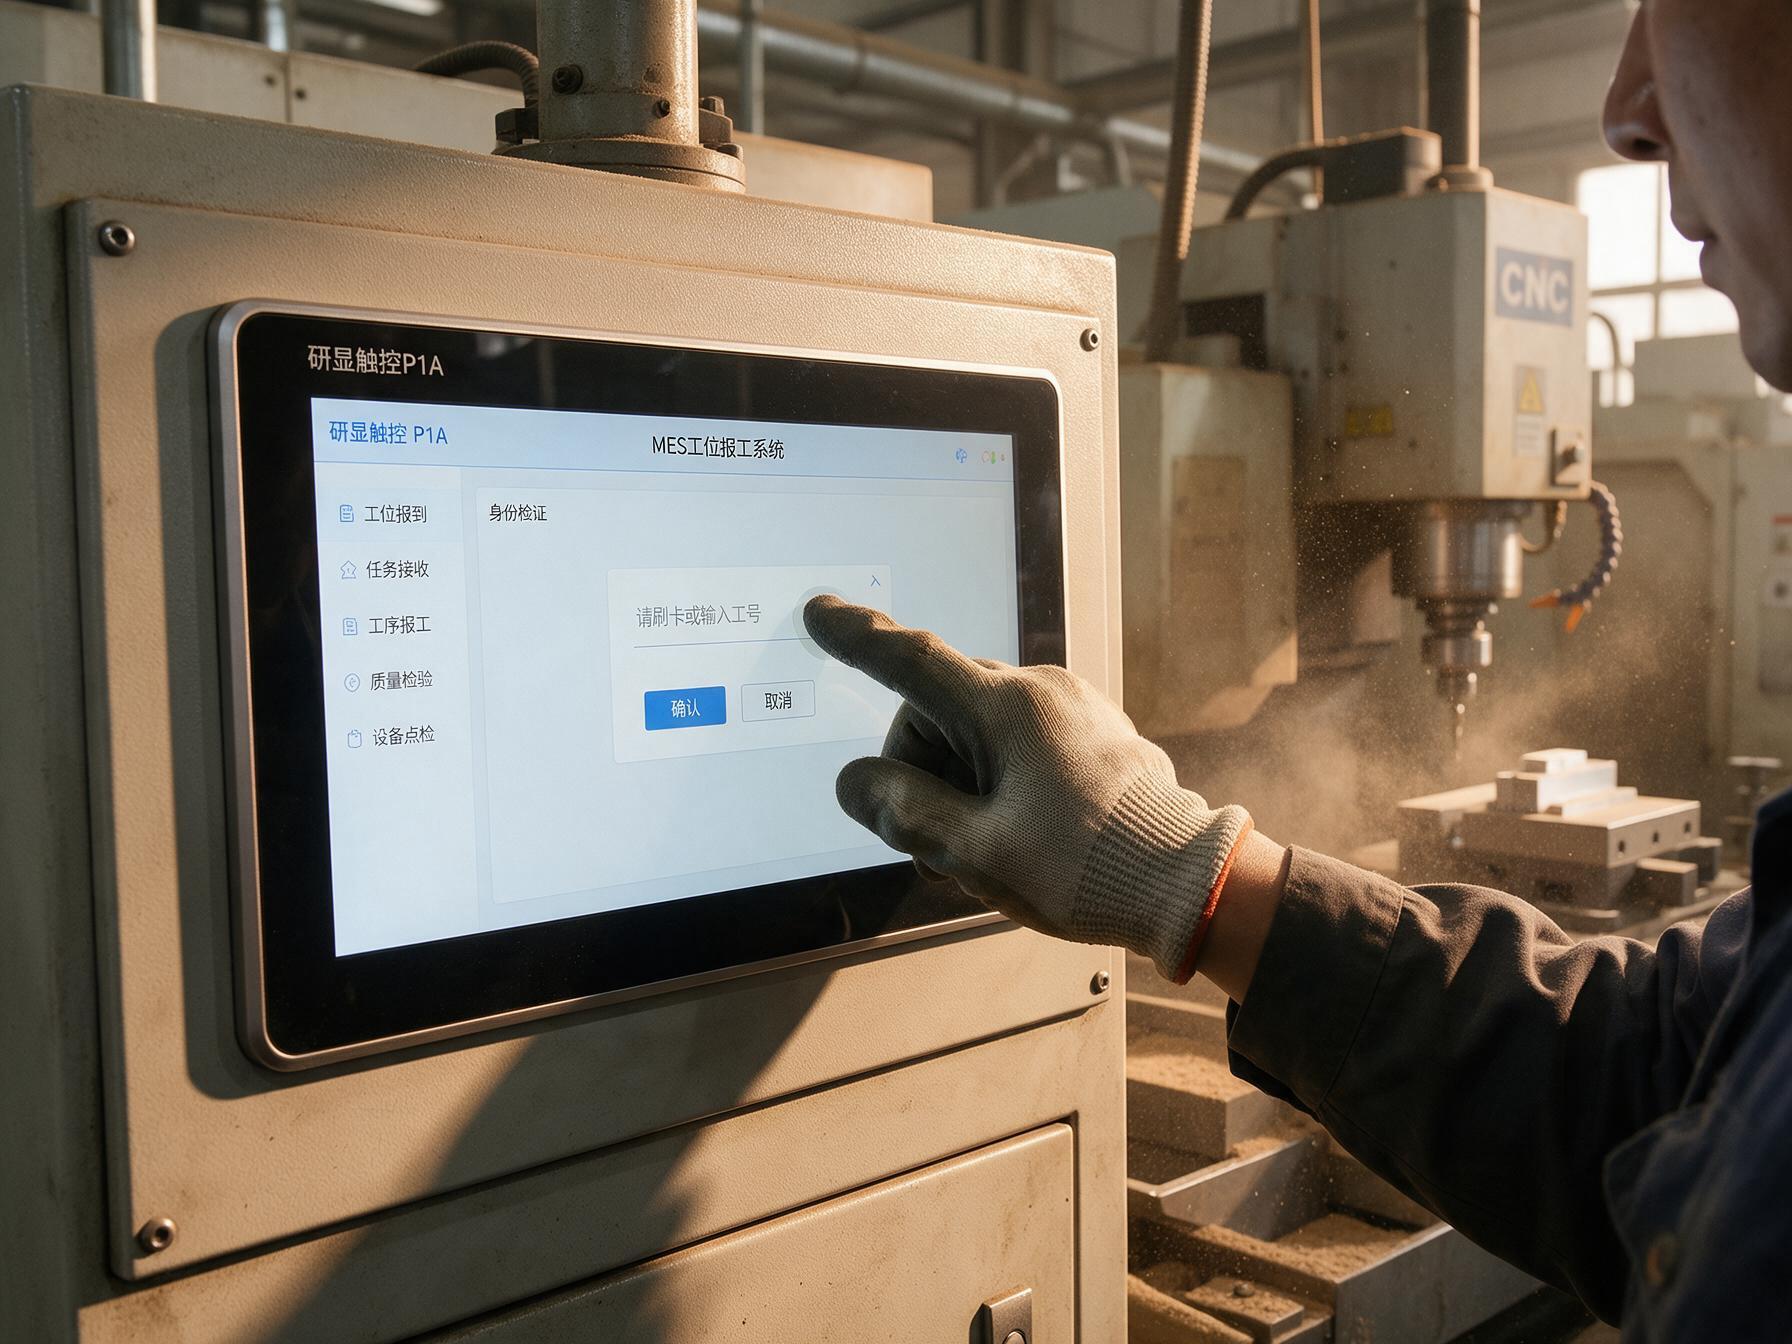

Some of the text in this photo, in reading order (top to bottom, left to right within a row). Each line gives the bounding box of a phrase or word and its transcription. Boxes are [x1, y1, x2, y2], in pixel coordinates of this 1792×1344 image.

[1501, 262, 1570, 315] CNC
[307, 345, 445, 377] 研显触控P1A
[329, 421, 449, 445] 研显触控 P1A
[651, 436, 786, 460] MES工位报工系统
[364, 504, 428, 524] 工位报到
[489, 503, 548, 522] 身份检证
[365, 560, 430, 580] 任务接收
[368, 615, 432, 635] 工序报工
[636, 603, 762, 629] 请刷卡或输入工号
[370, 669, 433, 691] 质量检验
[670, 698, 701, 719] 确认
[764, 690, 793, 711] 取消
[372, 724, 436, 747] 设备点检
